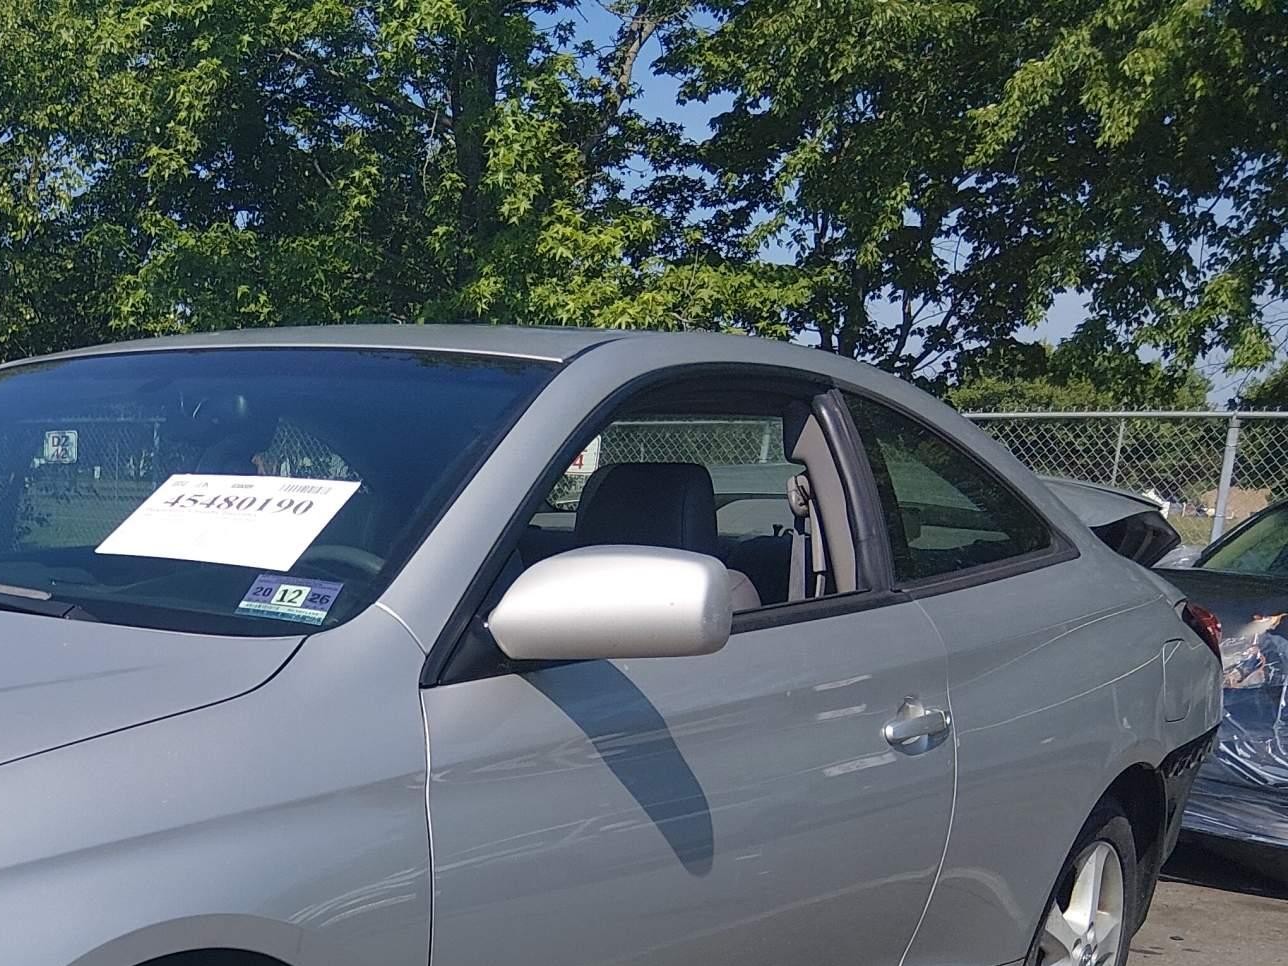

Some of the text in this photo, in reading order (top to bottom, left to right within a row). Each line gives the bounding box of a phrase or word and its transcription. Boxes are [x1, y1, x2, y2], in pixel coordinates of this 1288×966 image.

[52, 435, 69, 447] DZ
[163, 494, 314, 516] 45480190
[253, 586, 331, 604] 20 12 26
